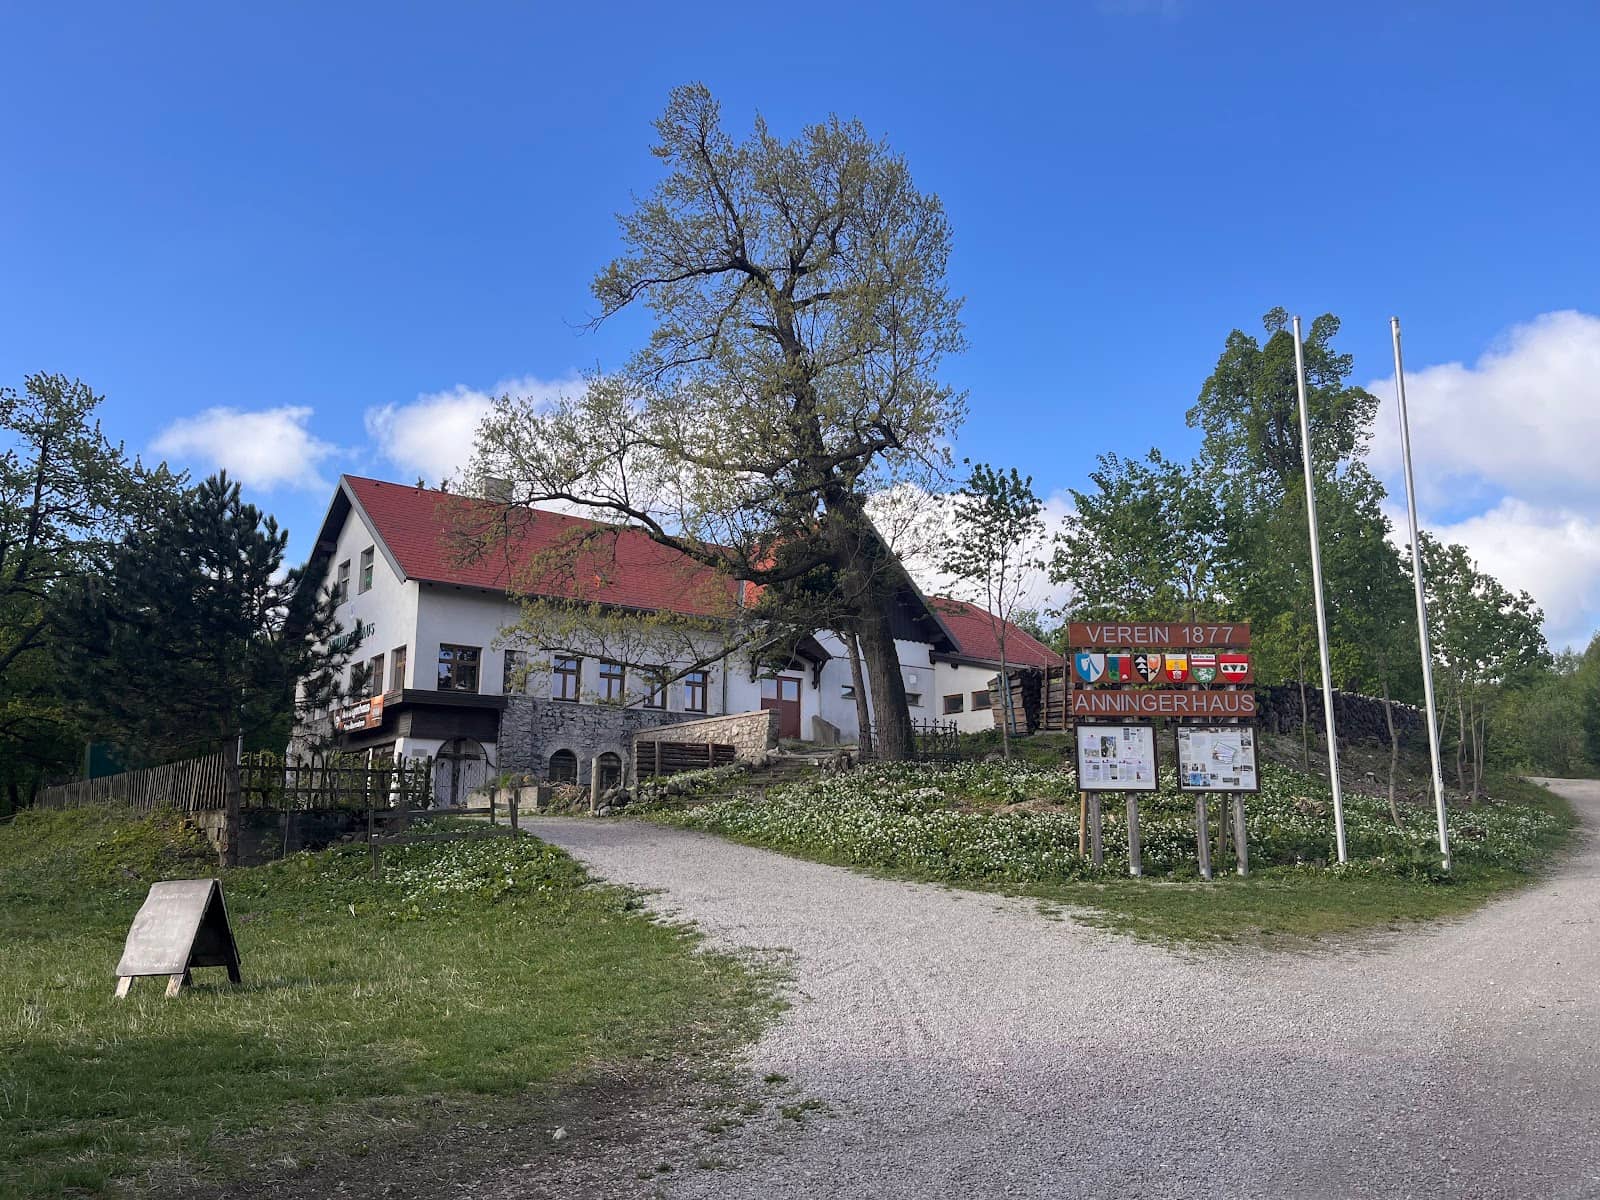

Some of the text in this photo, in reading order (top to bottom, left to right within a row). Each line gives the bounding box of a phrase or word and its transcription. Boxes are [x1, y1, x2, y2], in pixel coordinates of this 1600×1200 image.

[1086, 626, 1234, 644] VEREIN 1877
[1075, 694, 1255, 712] ANNINGERHAUS
